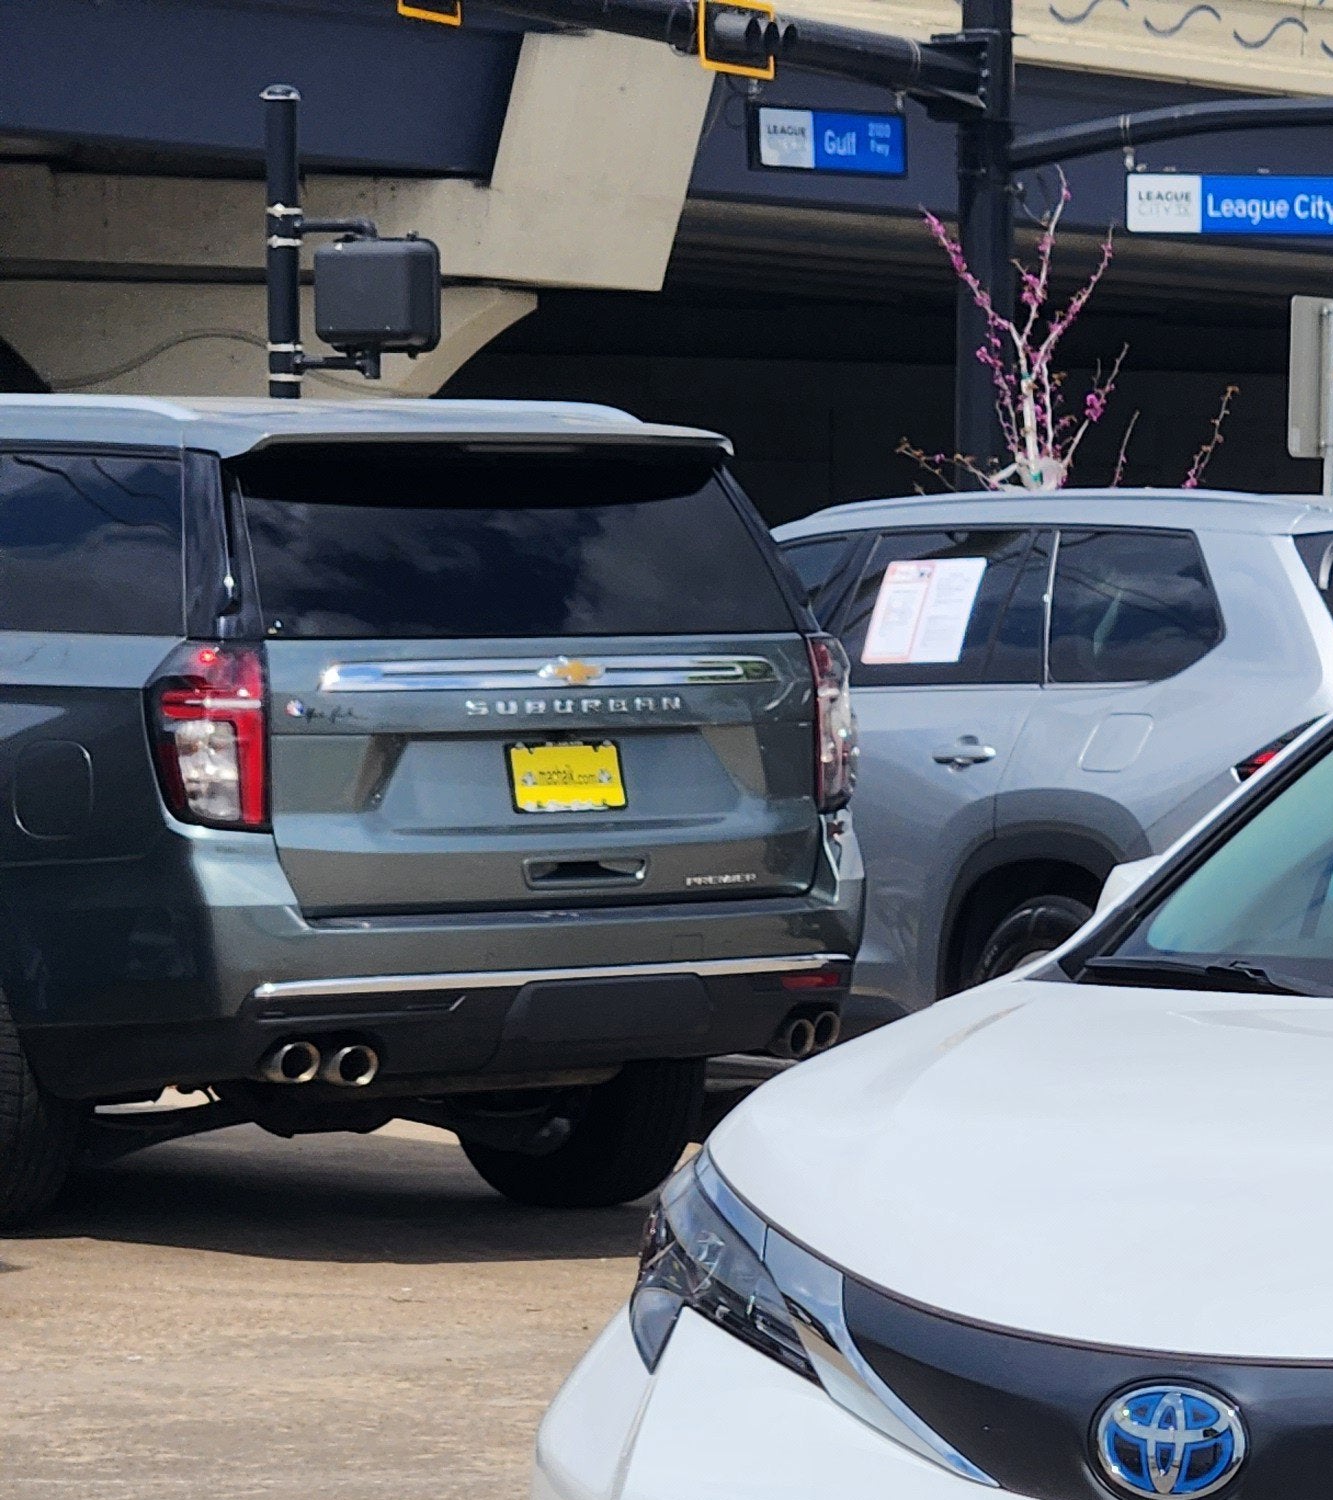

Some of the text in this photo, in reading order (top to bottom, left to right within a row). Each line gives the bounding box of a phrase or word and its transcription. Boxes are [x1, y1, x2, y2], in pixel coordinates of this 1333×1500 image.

[824, 129, 857, 156] Gulf
[1138, 190, 1192, 202] LEAGUE
[1207, 192, 1290, 226] League
[465, 696, 681, 716] SUBURBAN
